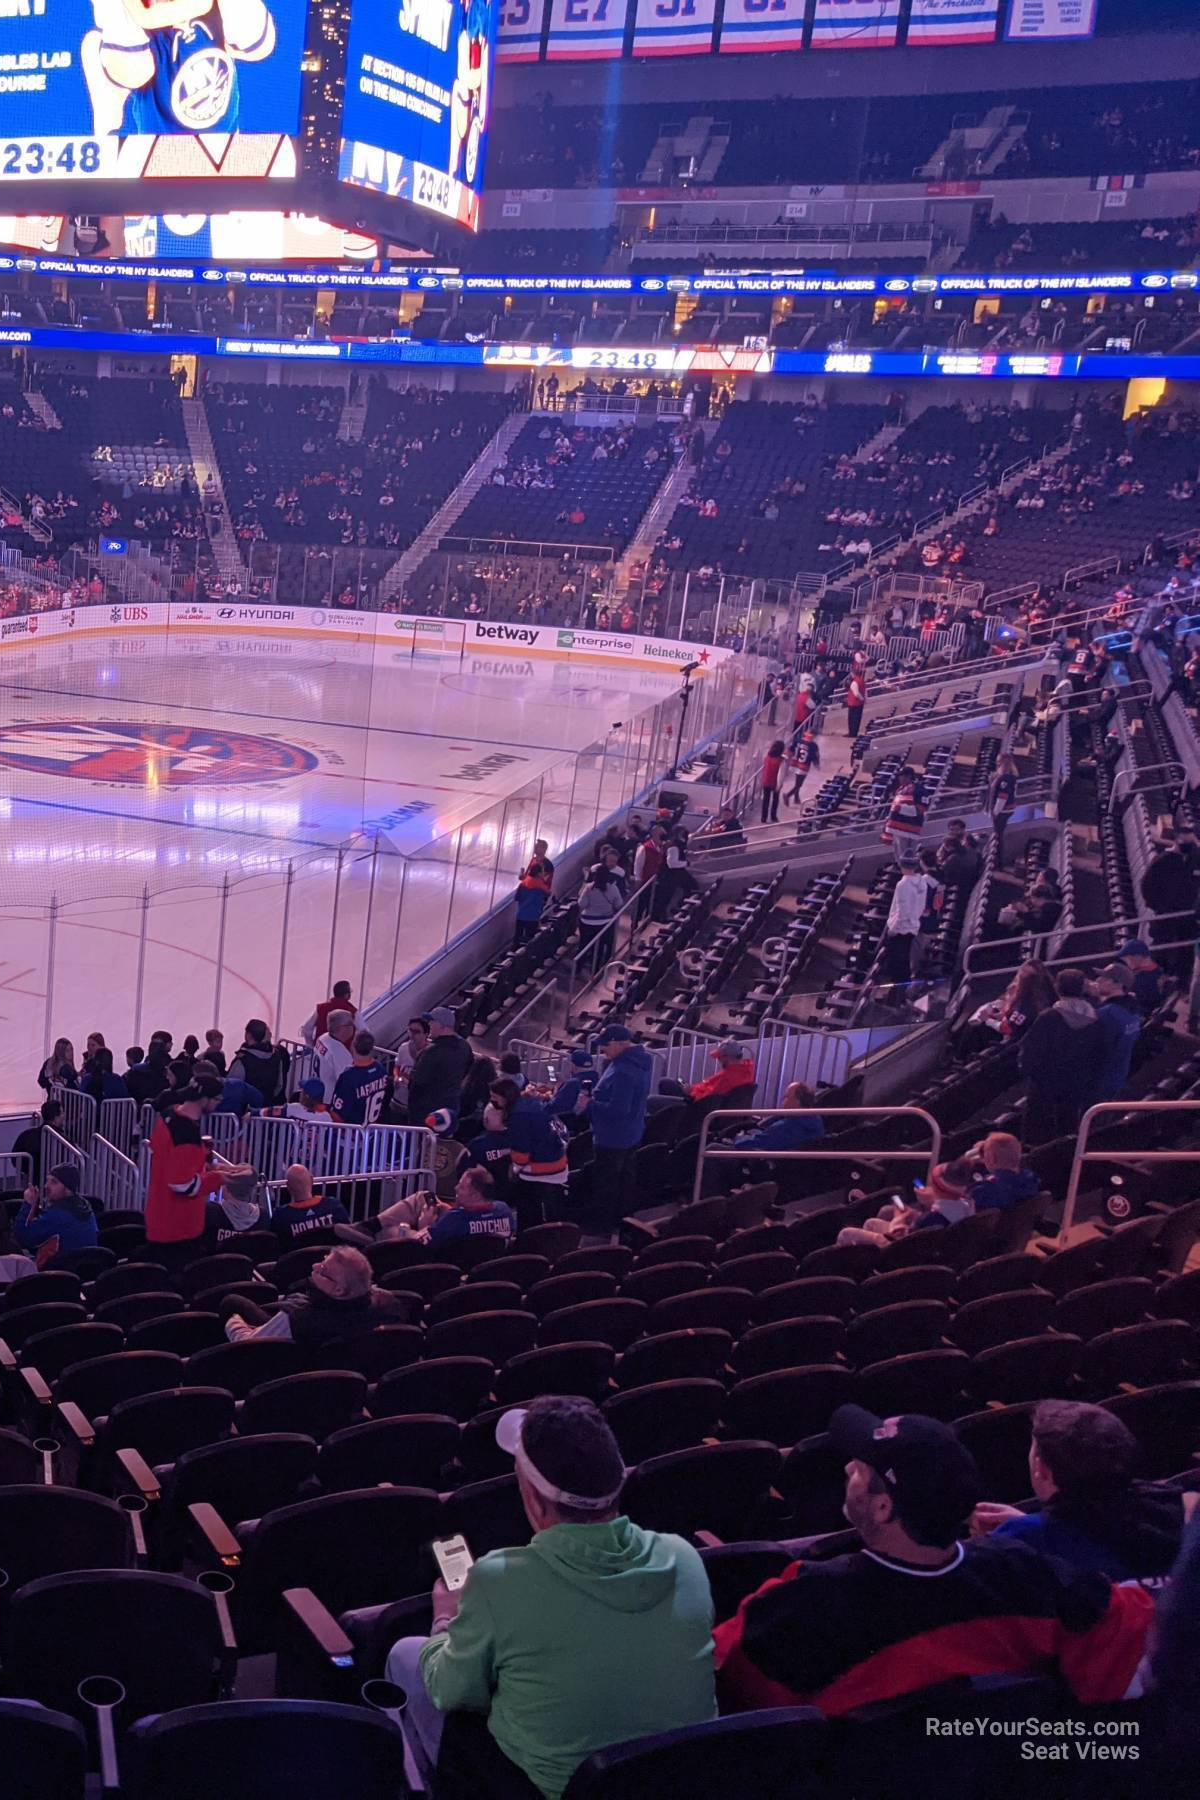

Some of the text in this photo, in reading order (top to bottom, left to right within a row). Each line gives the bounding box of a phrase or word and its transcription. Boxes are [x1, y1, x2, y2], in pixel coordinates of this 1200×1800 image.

[41, 53, 71, 69] LAB
[3, 142, 100, 175] 23:48
[418, 170, 450, 208] 23:48
[40, 261, 194, 279] OFFICIAL TRUCK OF THE NY ISLANDERS
[250, 272, 409, 287] OFFICIAL TRUCK OF THE NY ISLANDERS
[467, 278, 632, 289] OFFICIAL TRUCK OF THE NY ISLANDERS
[694, 280, 874, 290] OFFICIAL TRUCK OF THE NY ISLANDERS
[941, 276, 1130, 290] OFFICIAL TRUCK OF THE NY ISLANDERS
[590, 352, 657, 367] 23:48
[124, 608, 148, 620] UBS
[239, 609, 294, 620] HYUNDAI
[475, 622, 539, 645] betway
[562, 634, 632, 650] enterprise
[643, 644, 694, 661] Heineken
[364, 1091, 386, 1127] 16
[290, 1213, 334, 1237] HOWATT
